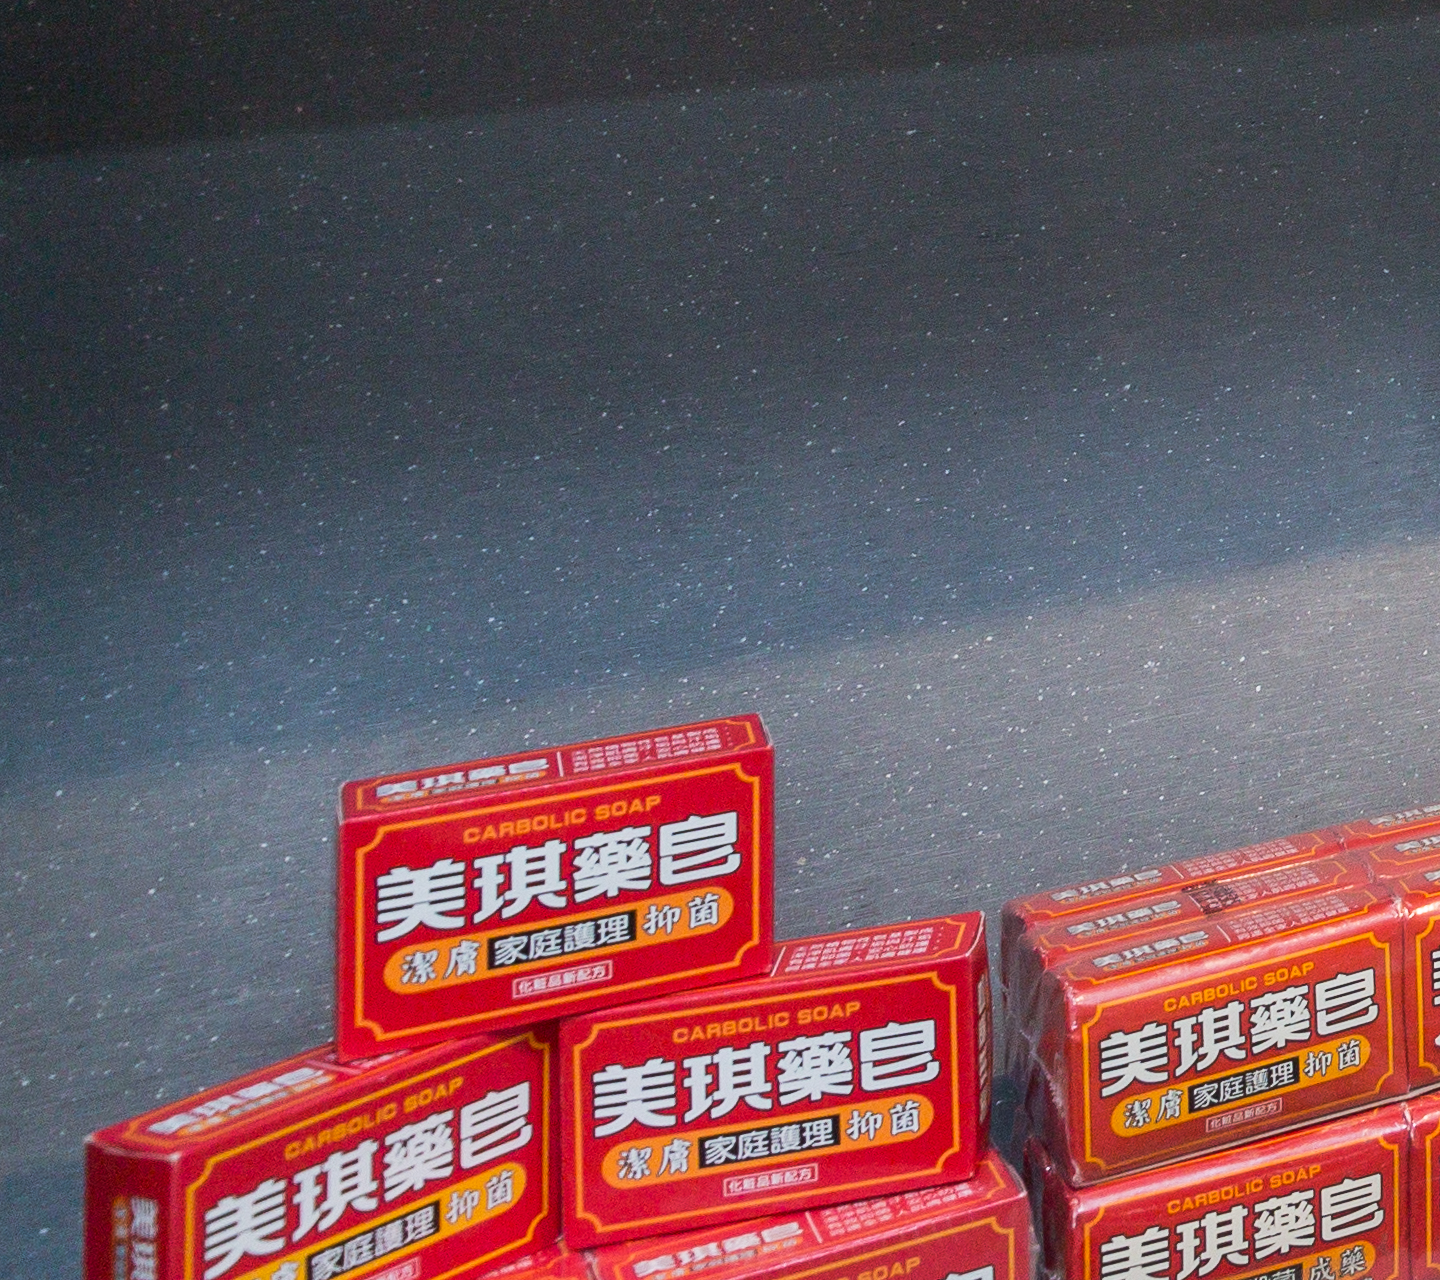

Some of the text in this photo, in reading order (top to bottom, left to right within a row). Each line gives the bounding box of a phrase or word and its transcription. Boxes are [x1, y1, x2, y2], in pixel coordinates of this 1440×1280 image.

[376, 811, 742, 943] 美琪藥皂
[462, 796, 661, 844] CARBOLIC SOAP
[400, 893, 720, 985] 潔膚 家庭護理 抑菌
[593, 1019, 940, 1138] 美琪藥皂
[1100, 968, 1380, 1098] 美琪藥皂
[1193, 1040, 1361, 1109] 家庭護理 抑菌
[204, 1081, 533, 1280] 美琪藥皂
